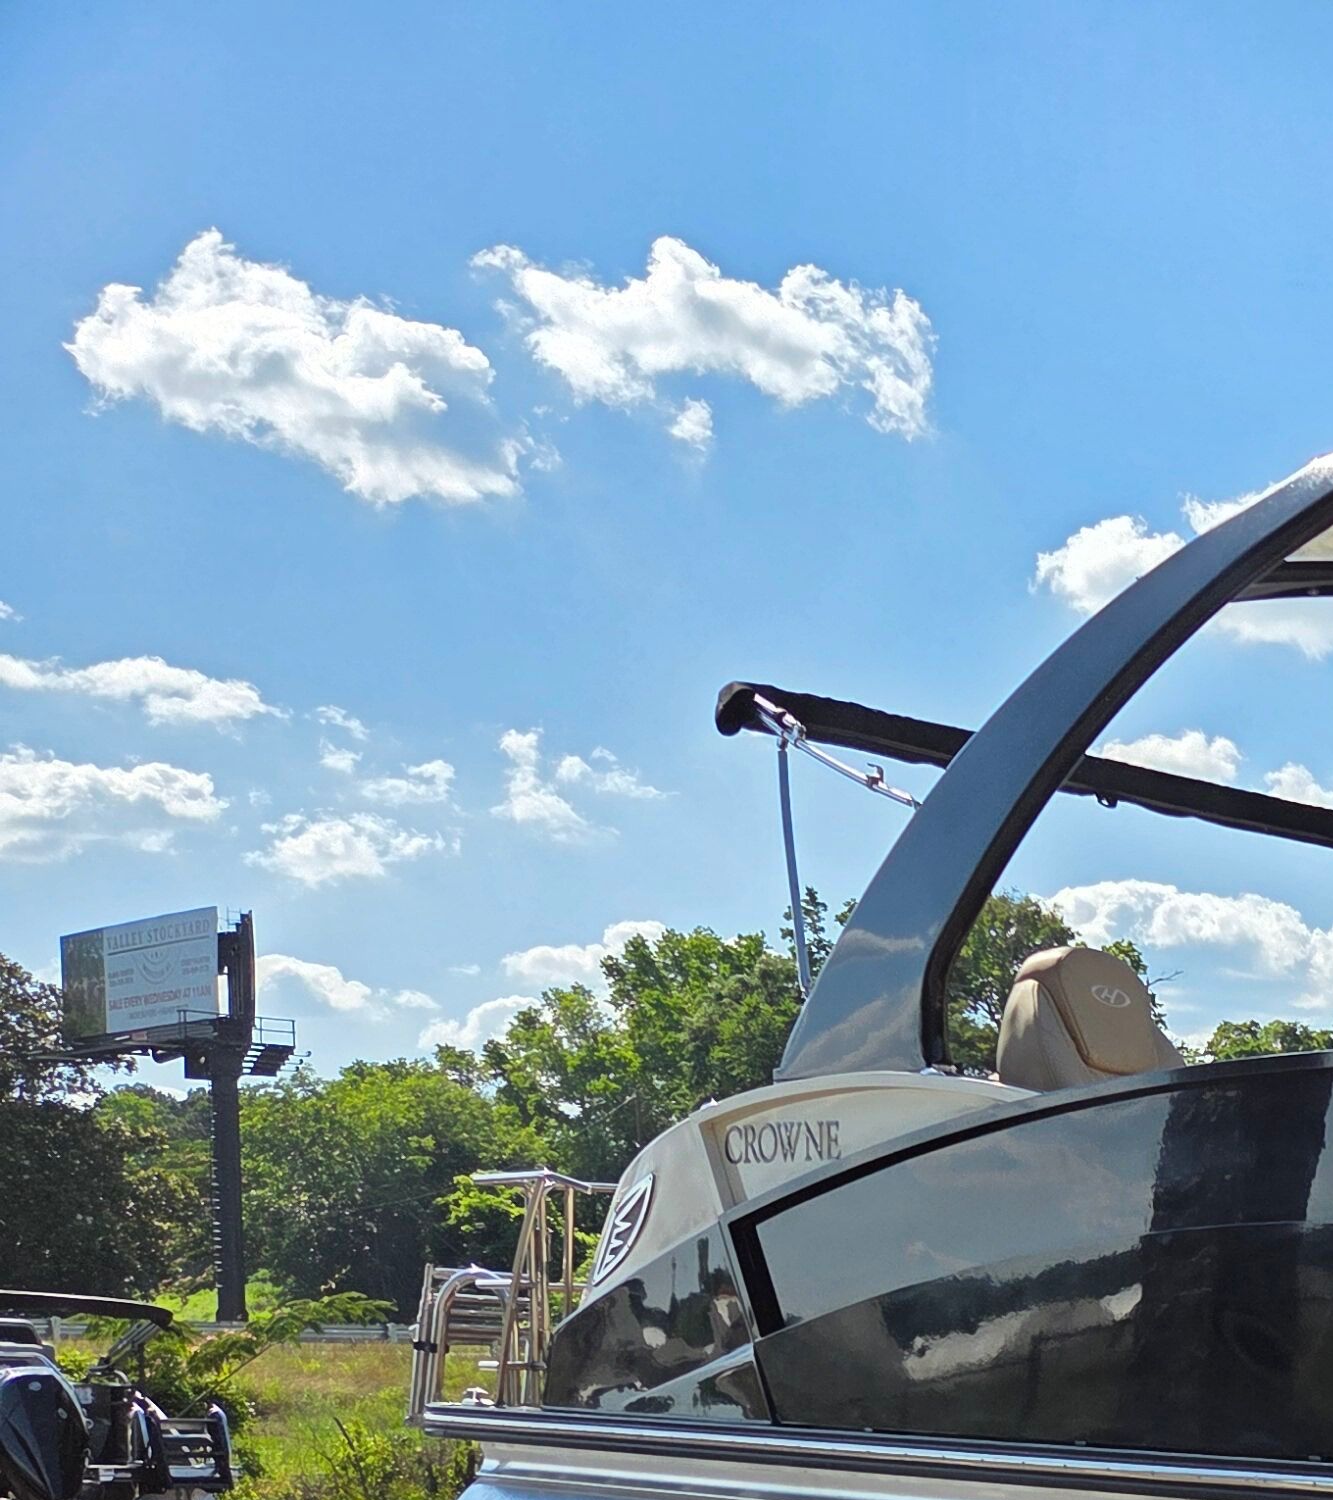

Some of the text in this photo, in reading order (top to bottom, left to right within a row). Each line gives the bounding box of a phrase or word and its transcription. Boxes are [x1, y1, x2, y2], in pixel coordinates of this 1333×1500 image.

[106, 918, 210, 951] VALLEY STOCKYARD
[724, 1120, 842, 1165] CROWNE
